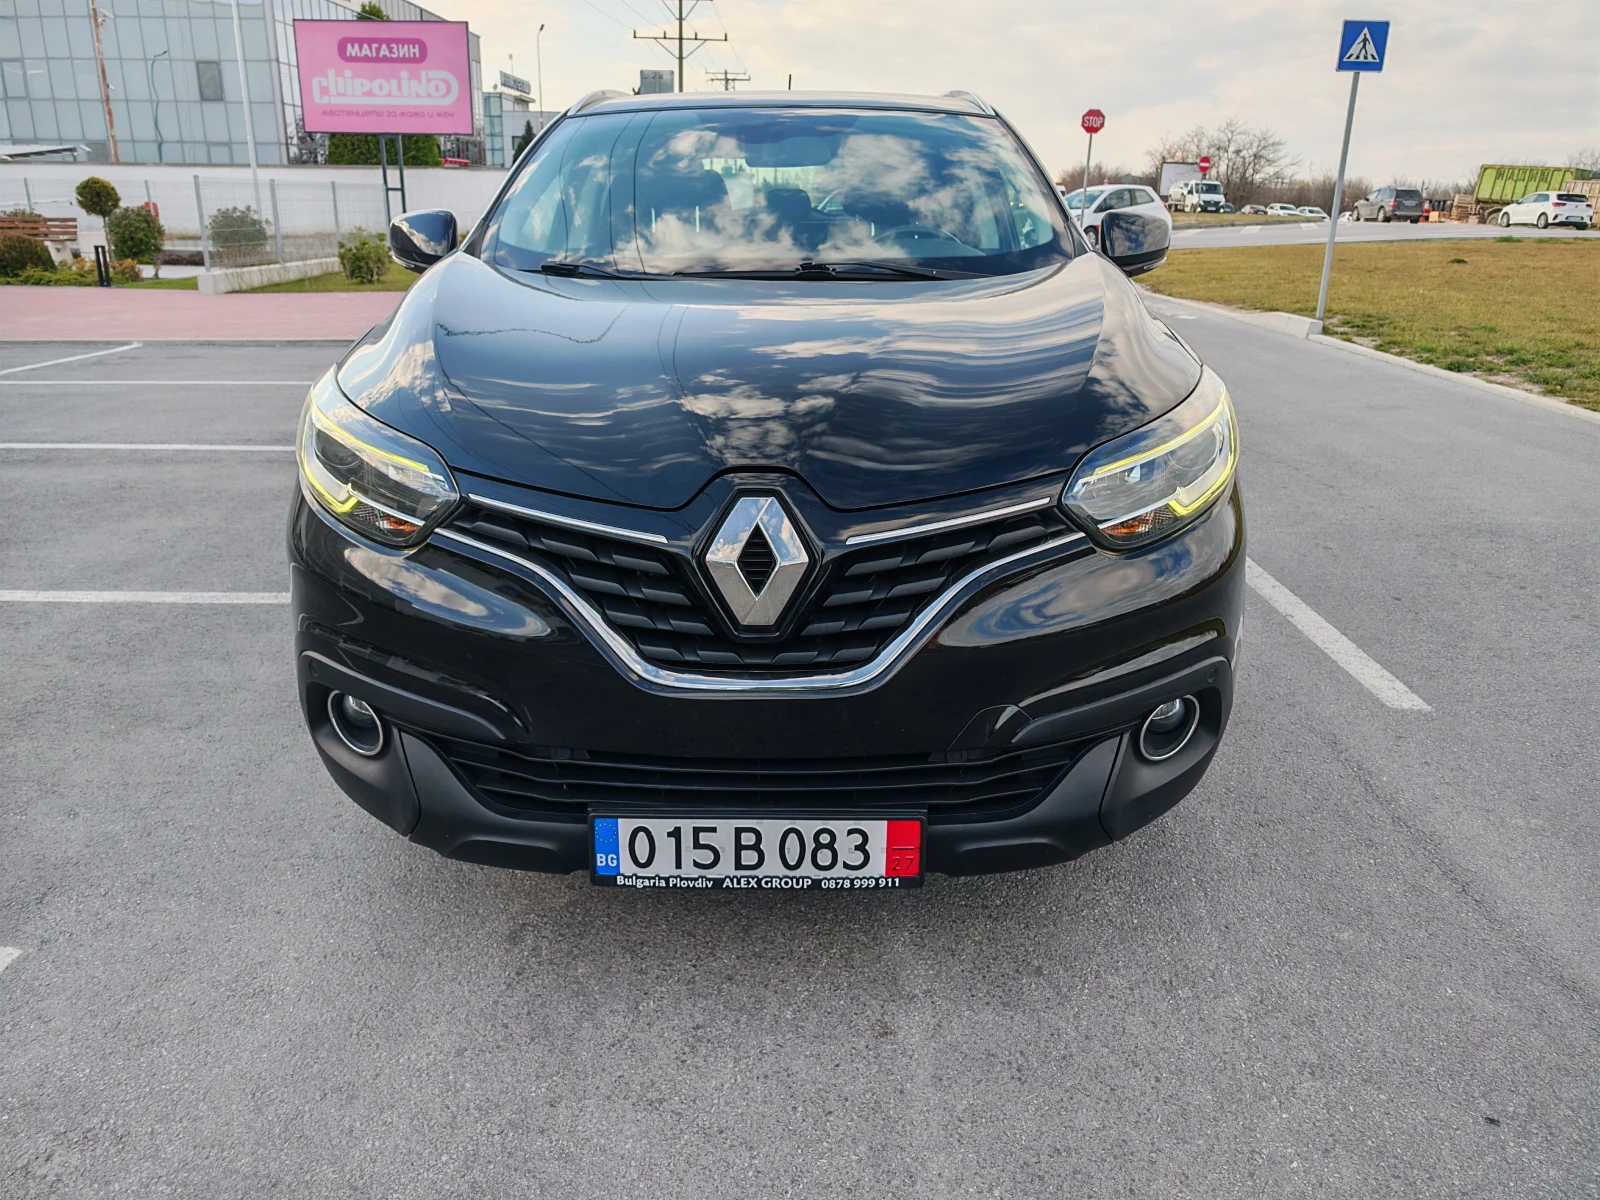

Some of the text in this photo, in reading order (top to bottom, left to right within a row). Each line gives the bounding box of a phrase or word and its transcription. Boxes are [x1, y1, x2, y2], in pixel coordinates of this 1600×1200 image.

[346, 43, 420, 58] МАГАЗИН
[386, 110, 397, 118] за
[398, 110, 426, 118] мама
[436, 111, 455, 119] мен
[1083, 116, 1104, 127] STOP
[596, 853, 618, 867] BG
[891, 856, 915, 871] 27
[616, 875, 900, 889] Bulgaria Plovdiv ALEX GROUP 0878 999 911
